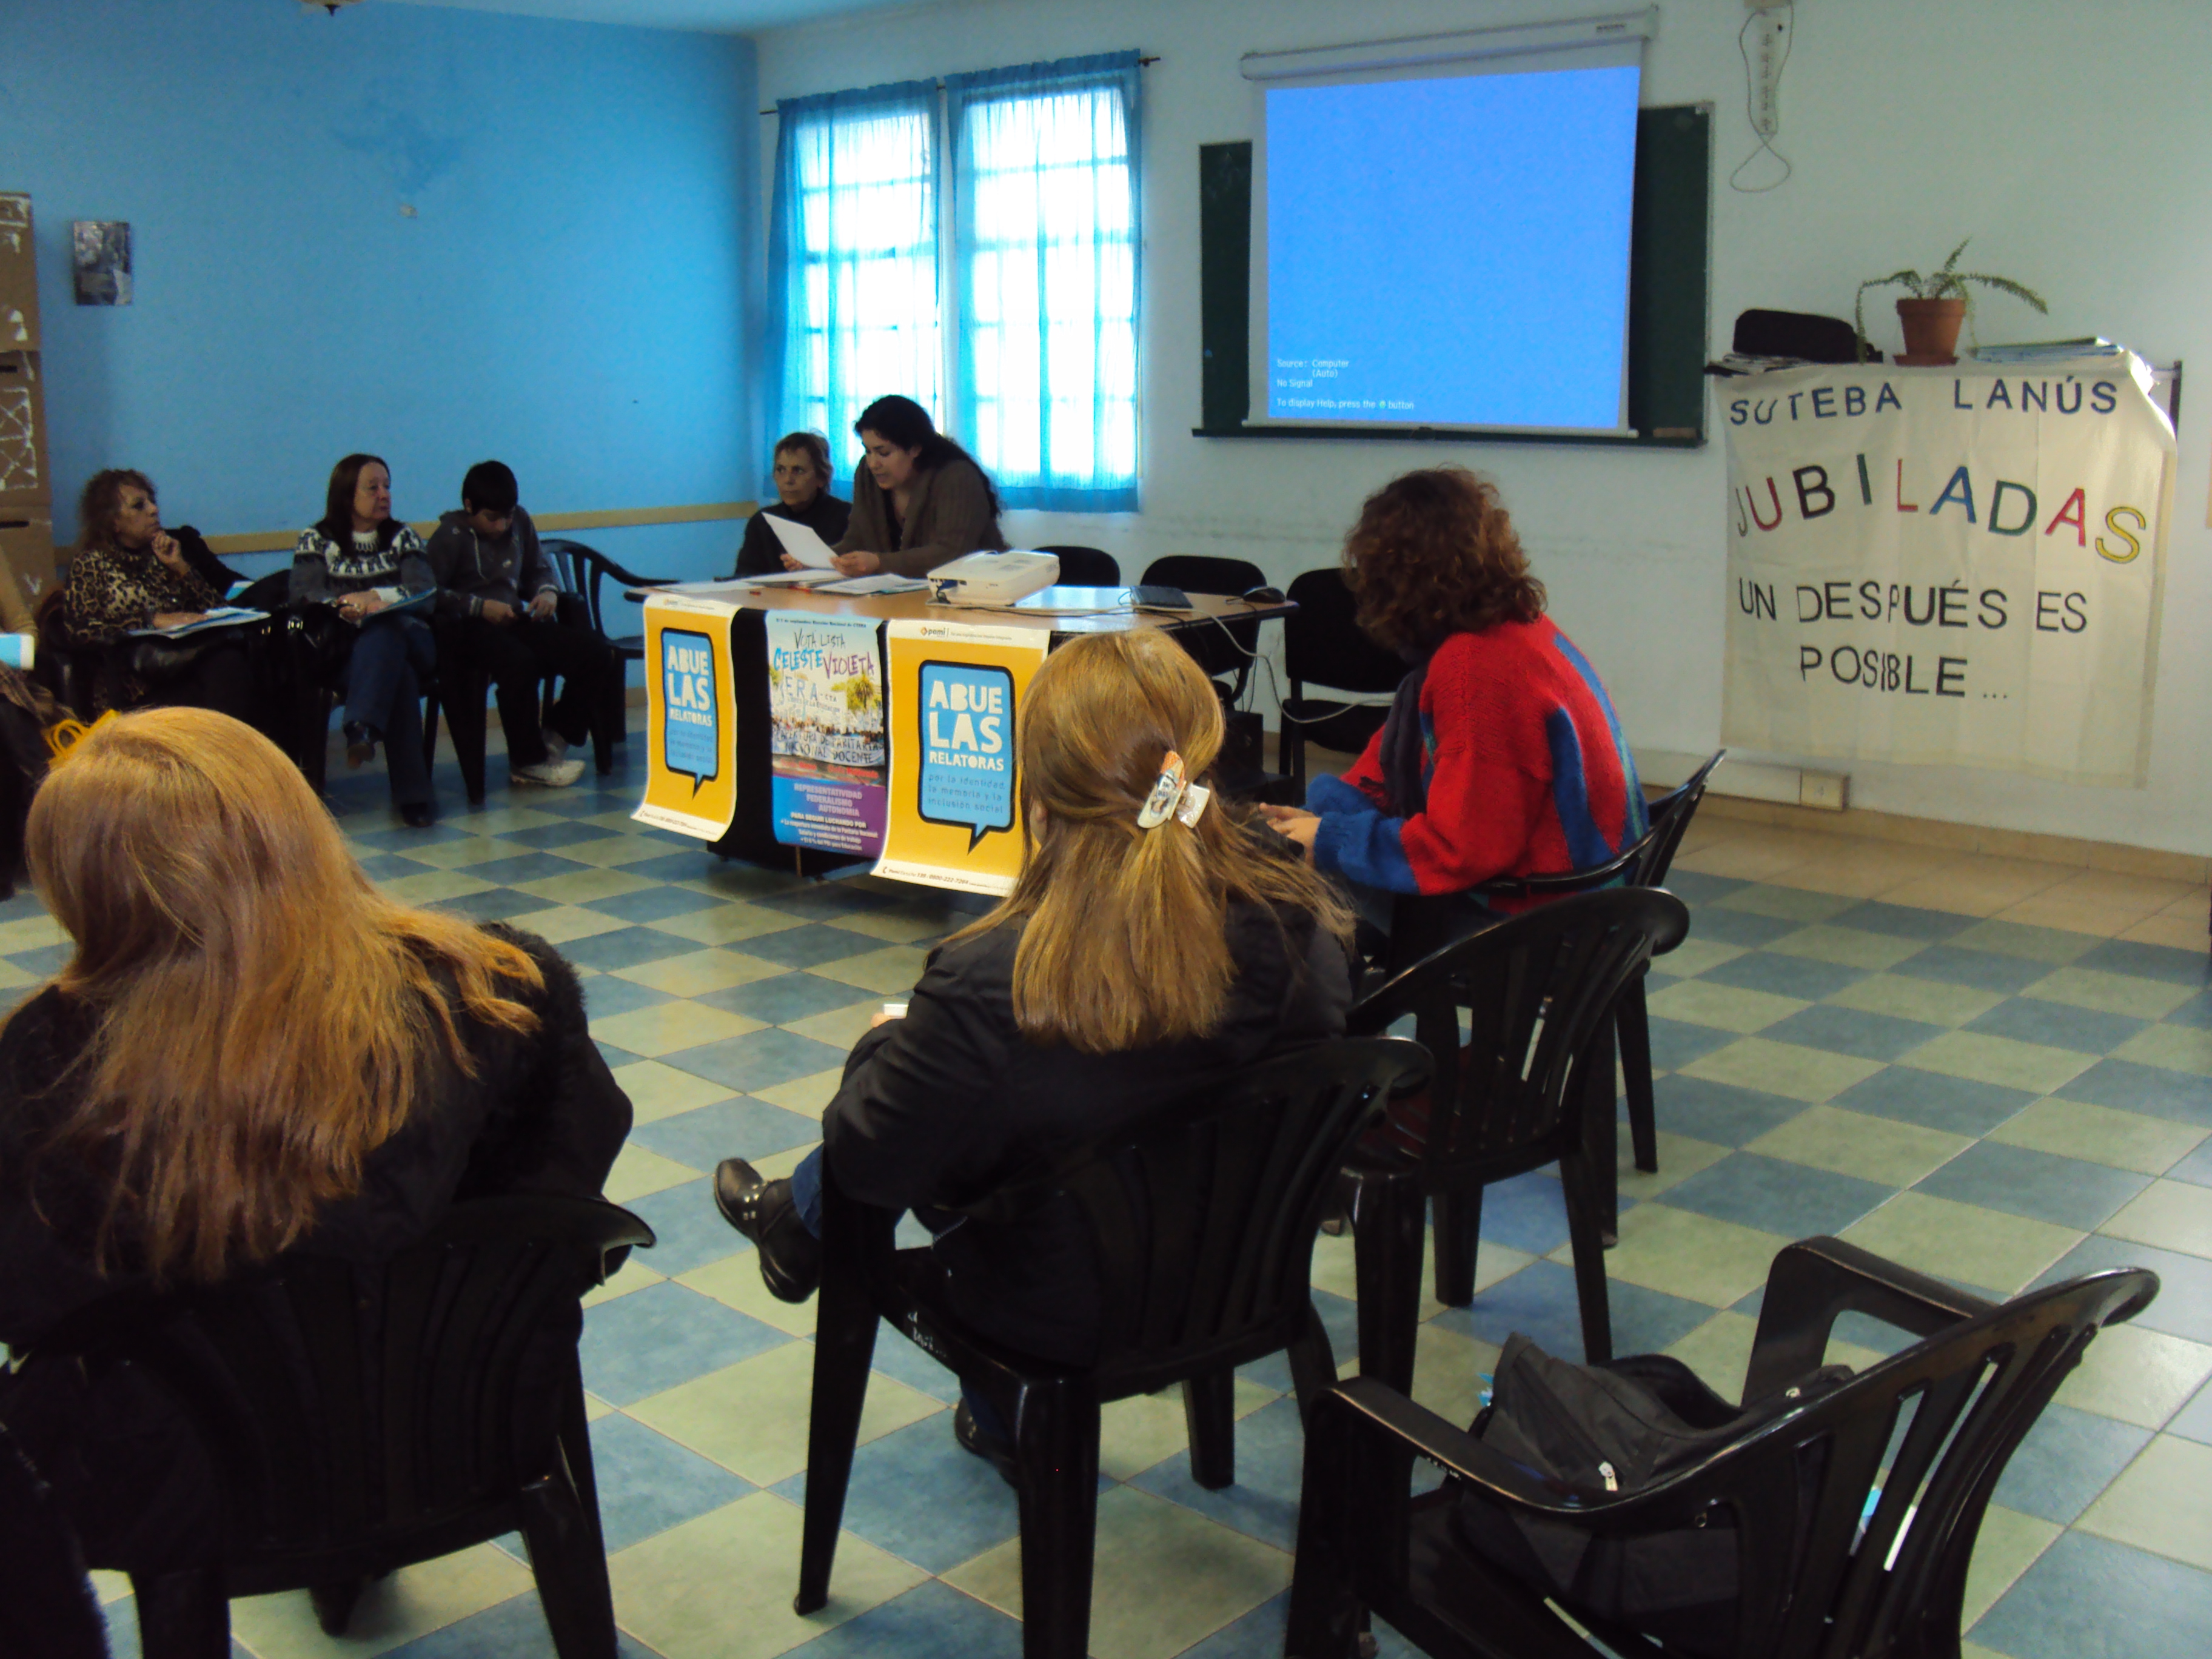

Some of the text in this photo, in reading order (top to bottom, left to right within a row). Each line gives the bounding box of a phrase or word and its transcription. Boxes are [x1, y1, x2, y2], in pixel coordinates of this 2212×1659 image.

[1276, 358, 1350, 369] Source: Computer
[1312, 368, 1338, 378] (Auto)
[1276, 378, 1313, 389] No Signal
[1276, 398, 1414, 409] To display Help, press the button
[1729, 375, 2118, 426] SUTEBA LANÚS
[1735, 452, 2147, 565] JUBILADAS
[1739, 577, 2088, 634] UN DESPUÉS ES
[794, 628, 846, 649] VOTA LISTA
[668, 645, 709, 676] ABUE
[774, 646, 875, 679] CELESTE VIOLETA
[668, 672, 711, 711] LAS
[928, 680, 1004, 715] ABUE
[669, 708, 712, 727] RELATORAS
[928, 711, 1003, 754] LAS
[929, 750, 1005, 773] RELATORAS
[928, 773, 943, 782] por
[948, 774, 956, 784] la
[928, 784, 939, 793] la
[941, 788, 980, 799] memoria
[993, 791, 1002, 802] la
[974, 803, 1004, 814] social
